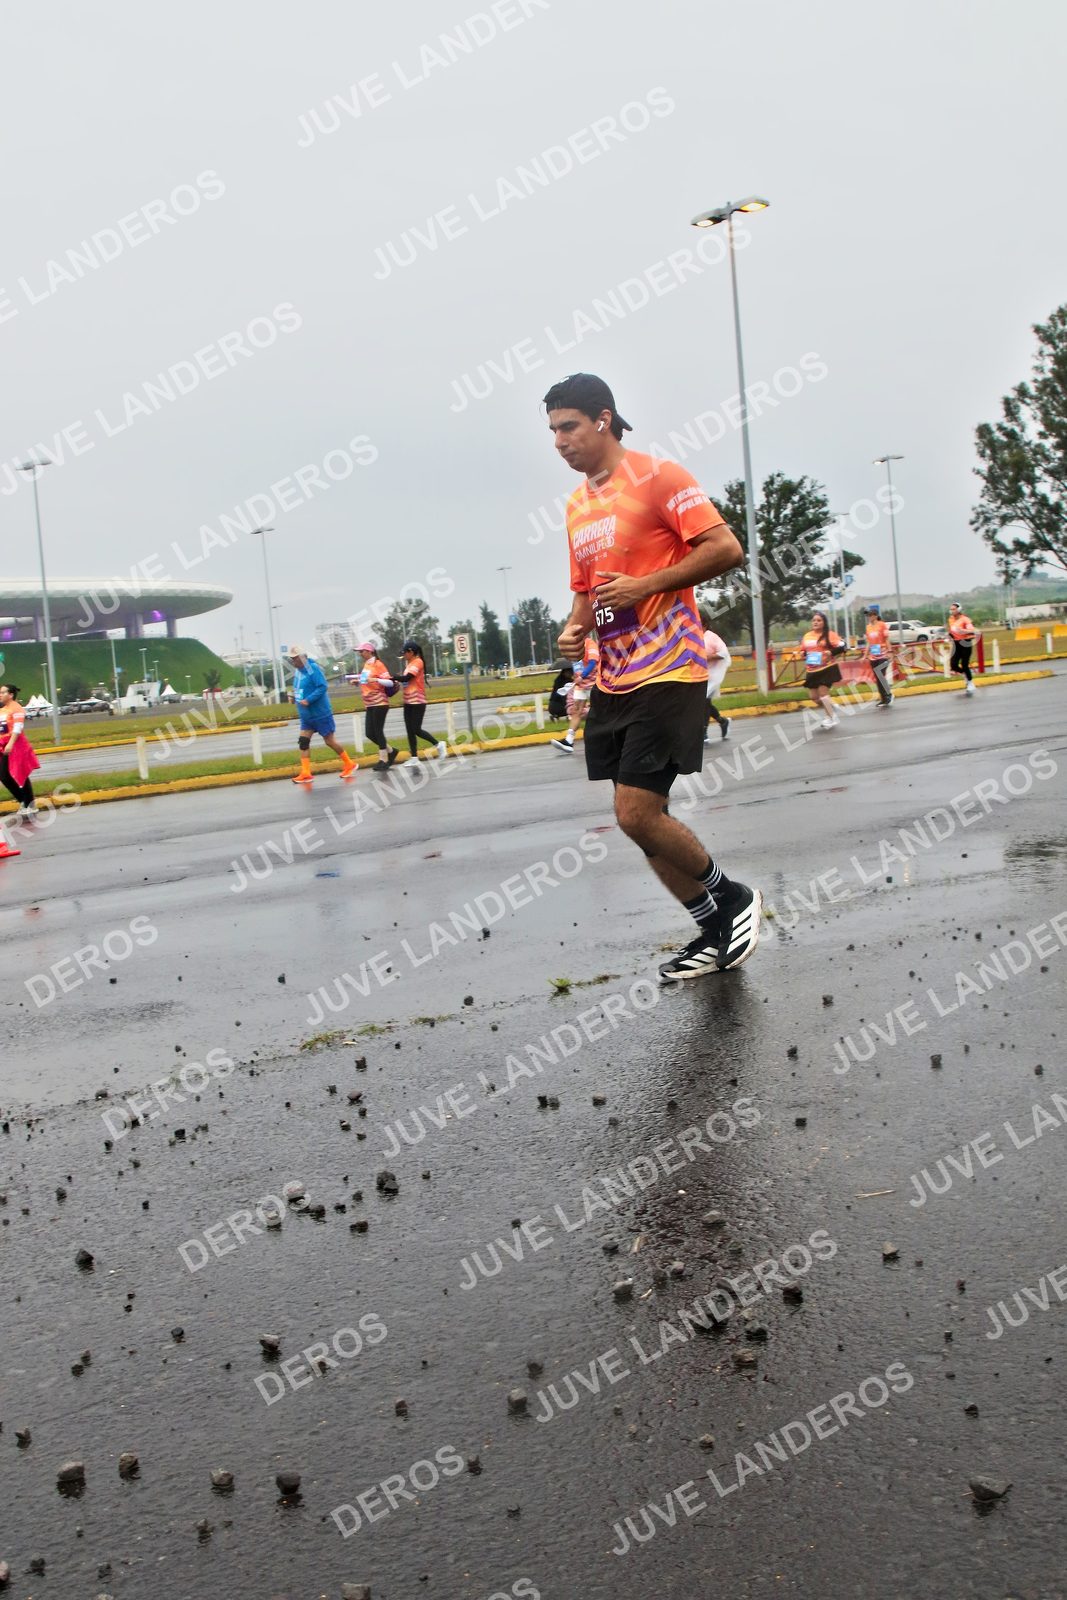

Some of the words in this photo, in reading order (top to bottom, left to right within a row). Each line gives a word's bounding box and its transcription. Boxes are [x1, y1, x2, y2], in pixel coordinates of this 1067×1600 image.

[573, 514, 616, 550] CARRERA
[575, 538, 606, 562] OMNILIFE
[595, 606, 615, 627] 675
